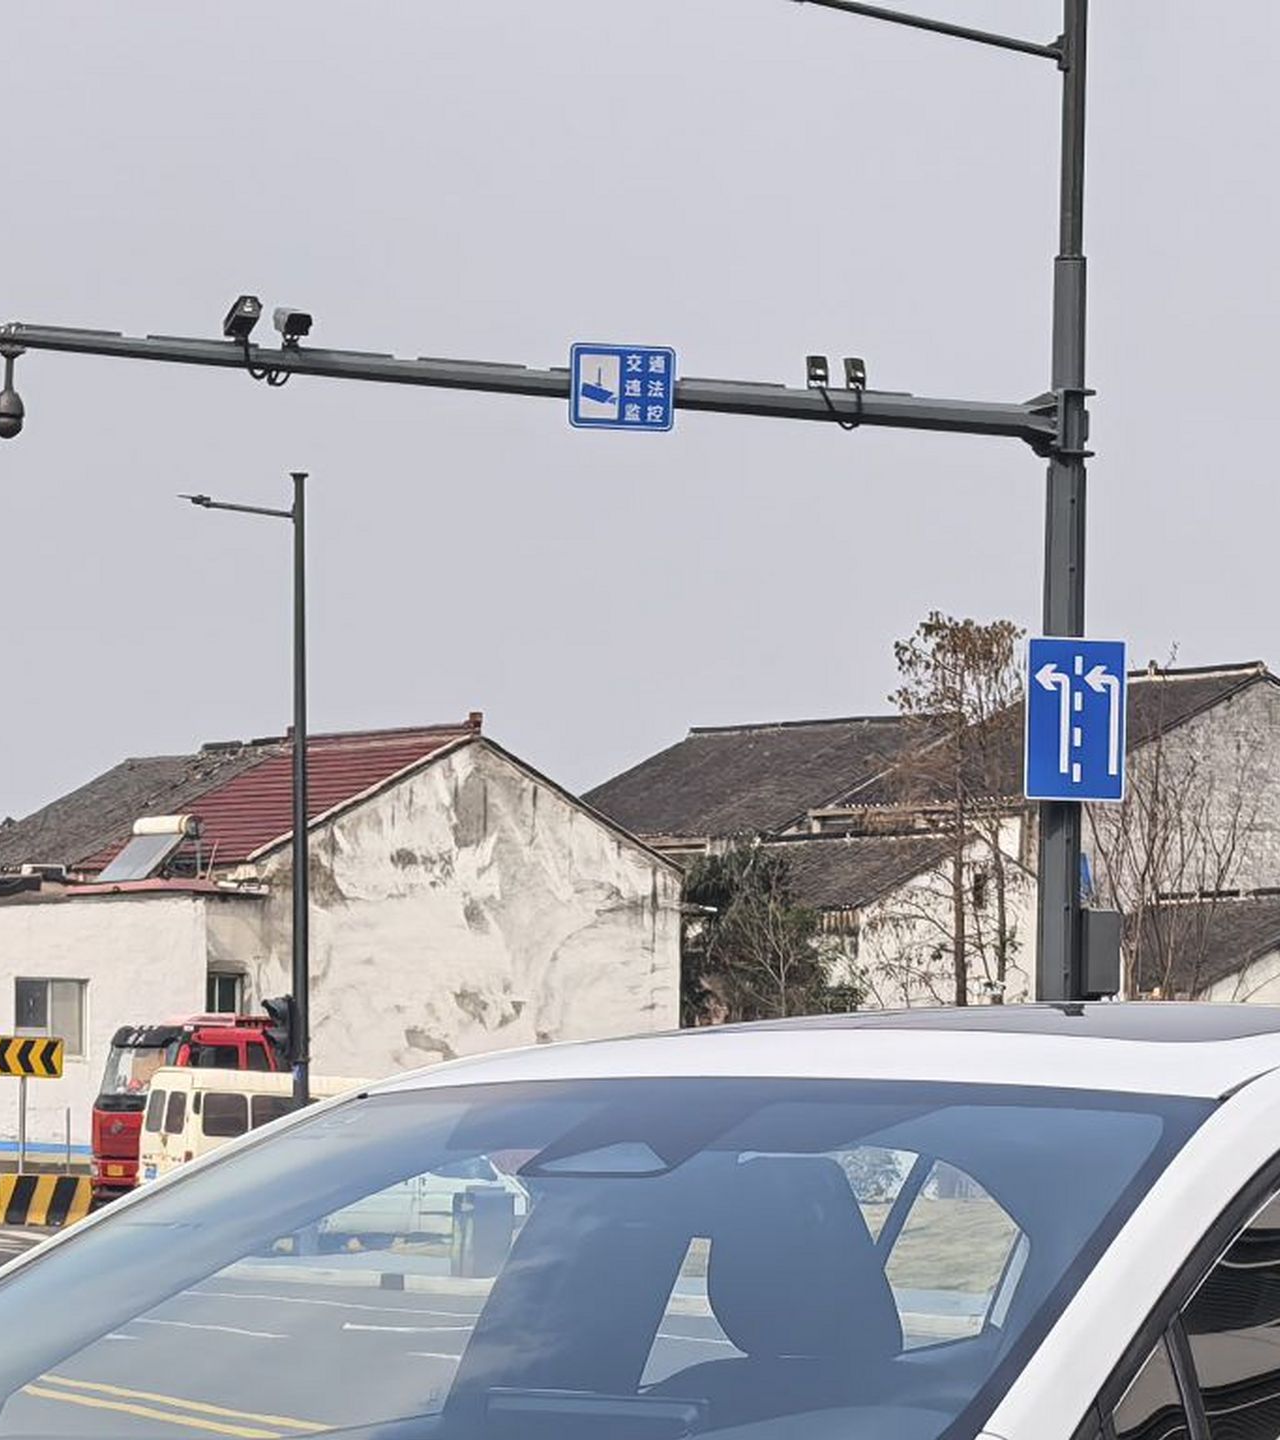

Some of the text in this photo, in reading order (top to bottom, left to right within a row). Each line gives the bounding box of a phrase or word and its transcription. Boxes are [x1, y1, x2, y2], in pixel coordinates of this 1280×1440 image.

[626, 354, 666, 374] 交通
[624, 379, 665, 399] 违法
[624, 403, 664, 423] 监控
